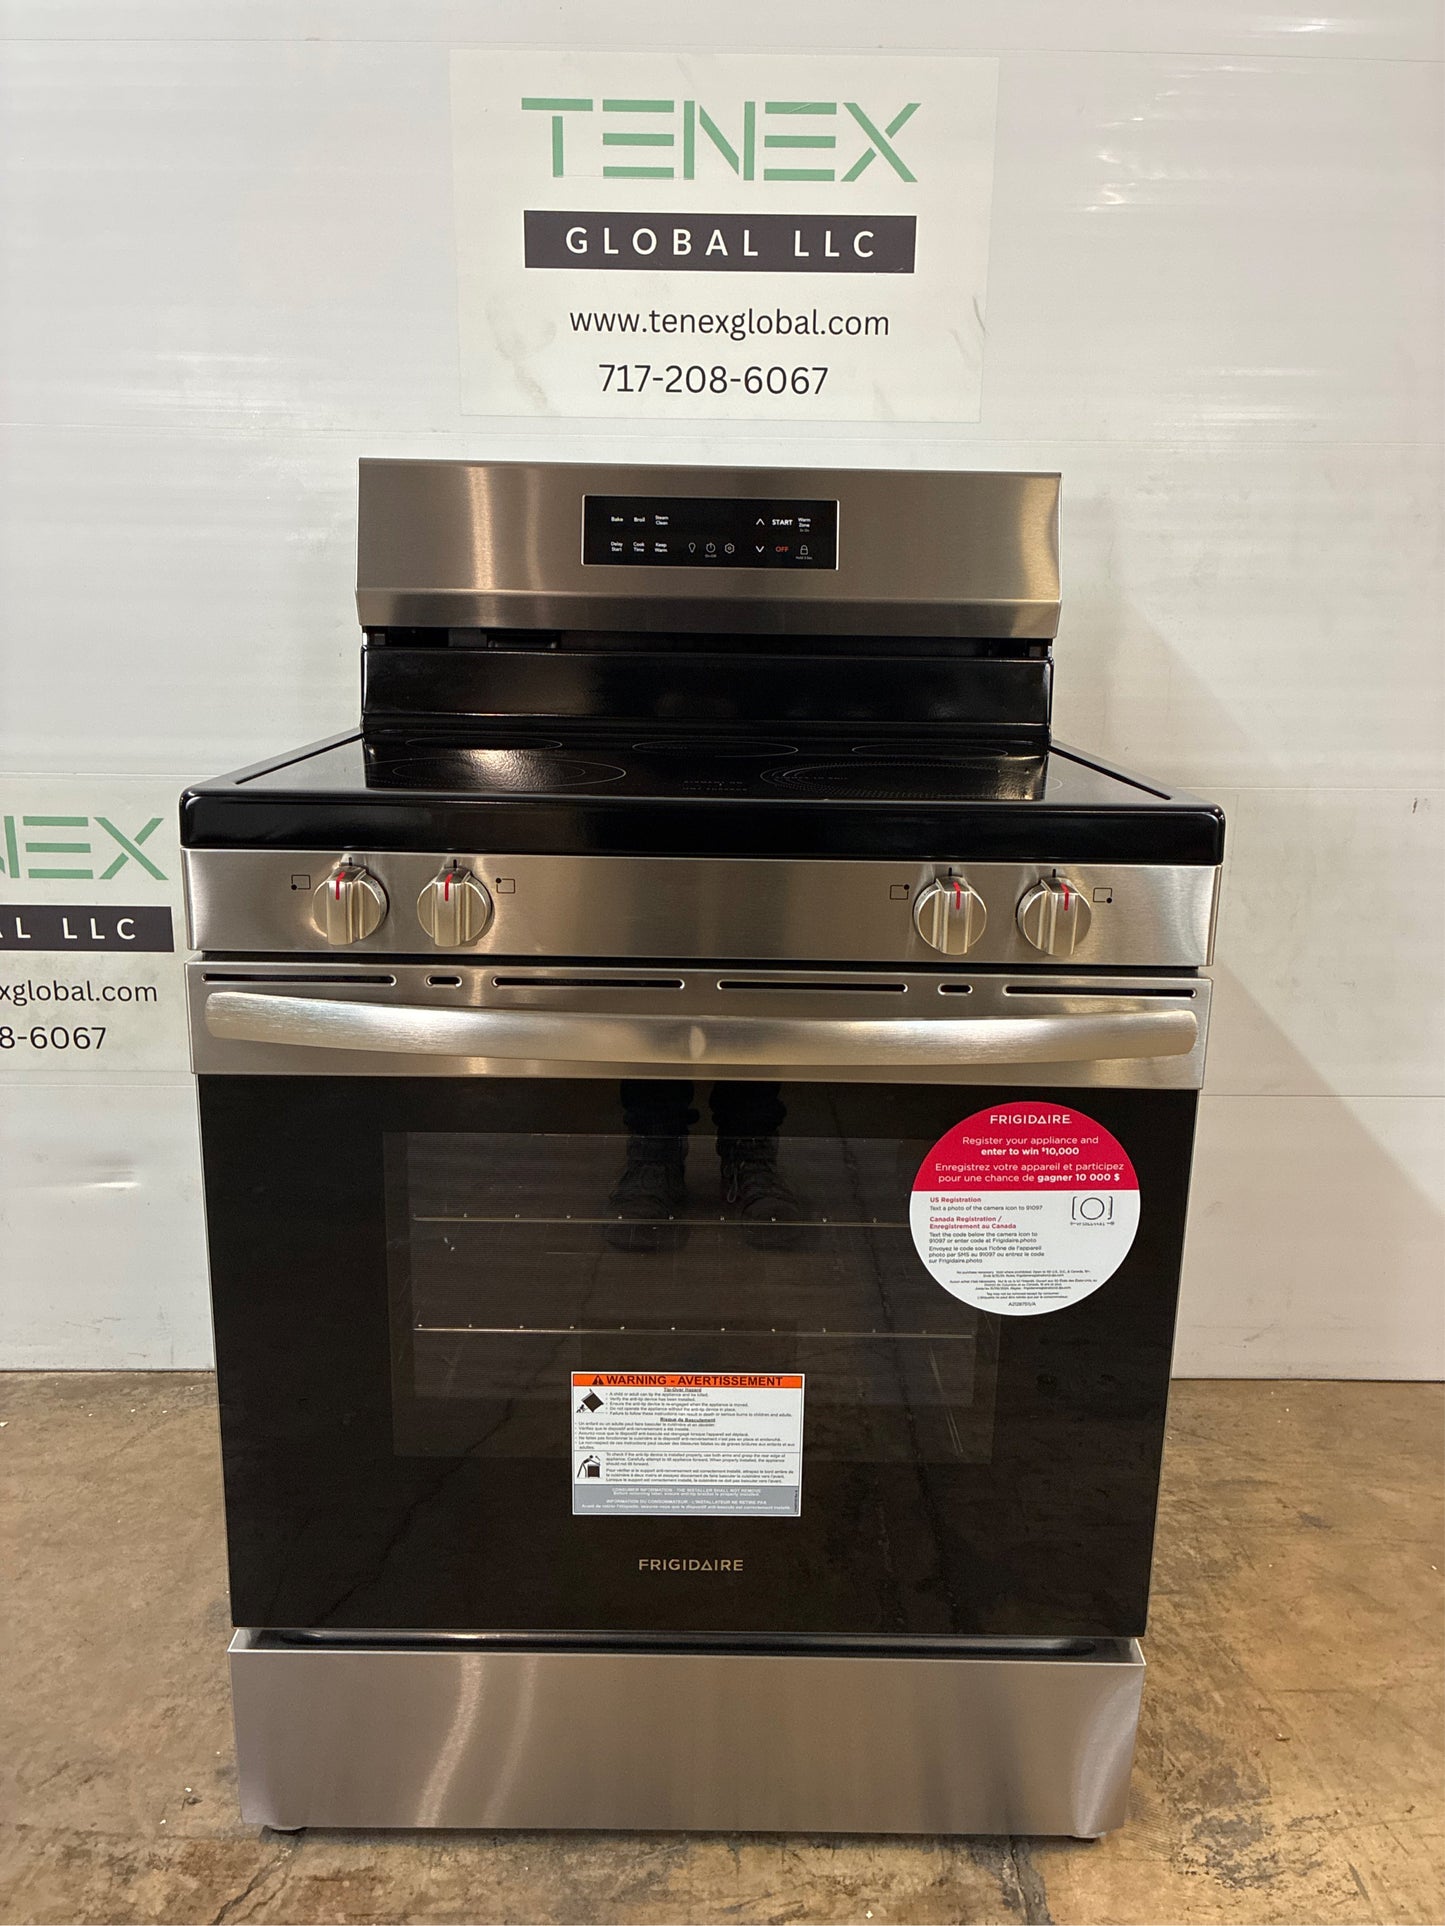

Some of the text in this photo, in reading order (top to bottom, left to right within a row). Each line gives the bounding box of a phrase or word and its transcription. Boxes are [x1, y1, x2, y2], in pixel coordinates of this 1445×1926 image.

[521, 97, 922, 183] TENEX
[565, 226, 876, 258] GLOBAL LLC
[569, 308, 890, 341] www.tenexglobal.com
[598, 363, 829, 395] 717-208-6067
[62, 917, 136, 940] LLC
[0, 1026, 107, 1049] 8-6067
[990, 1114, 1072, 1125] FRIGIDAIRE
[962, 1136, 1099, 1146] Register your appliance and
[1042, 1147, 1080, 1156] $10,000
[935, 1162, 1124, 1173] Enregistrez votre appareil et participez
[938, 1176, 961, 1184] pour
[984, 1174, 1020, 1182] chance
[1022, 1173, 1035, 1181] de
[1037, 1175, 1073, 1183] gagner
[1075, 1173, 1087, 1181] 10
[1089, 1173, 1111, 1181] 000
[1114, 1173, 1120, 1181] $
[606, 1376, 667, 1385] WARNING
[678, 1376, 783, 1386] AVERTISSEMENT
[638, 1559, 744, 1571] FRIGIDAIRE
